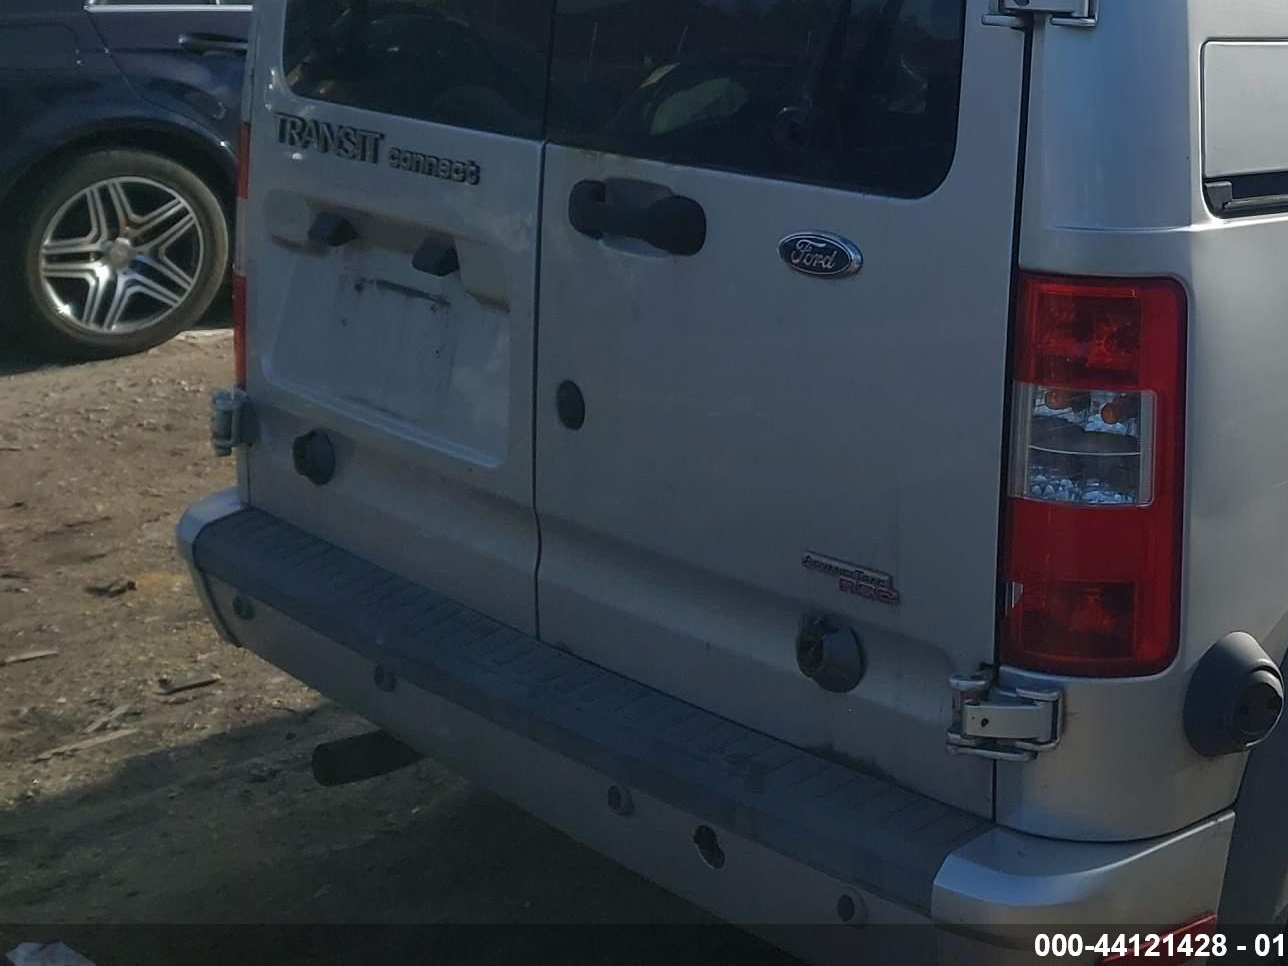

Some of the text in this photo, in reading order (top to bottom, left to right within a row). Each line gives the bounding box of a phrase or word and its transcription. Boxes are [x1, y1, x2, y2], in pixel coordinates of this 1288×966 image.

[274, 112, 481, 187] TRANSIT connect
[790, 239, 837, 269] Ford
